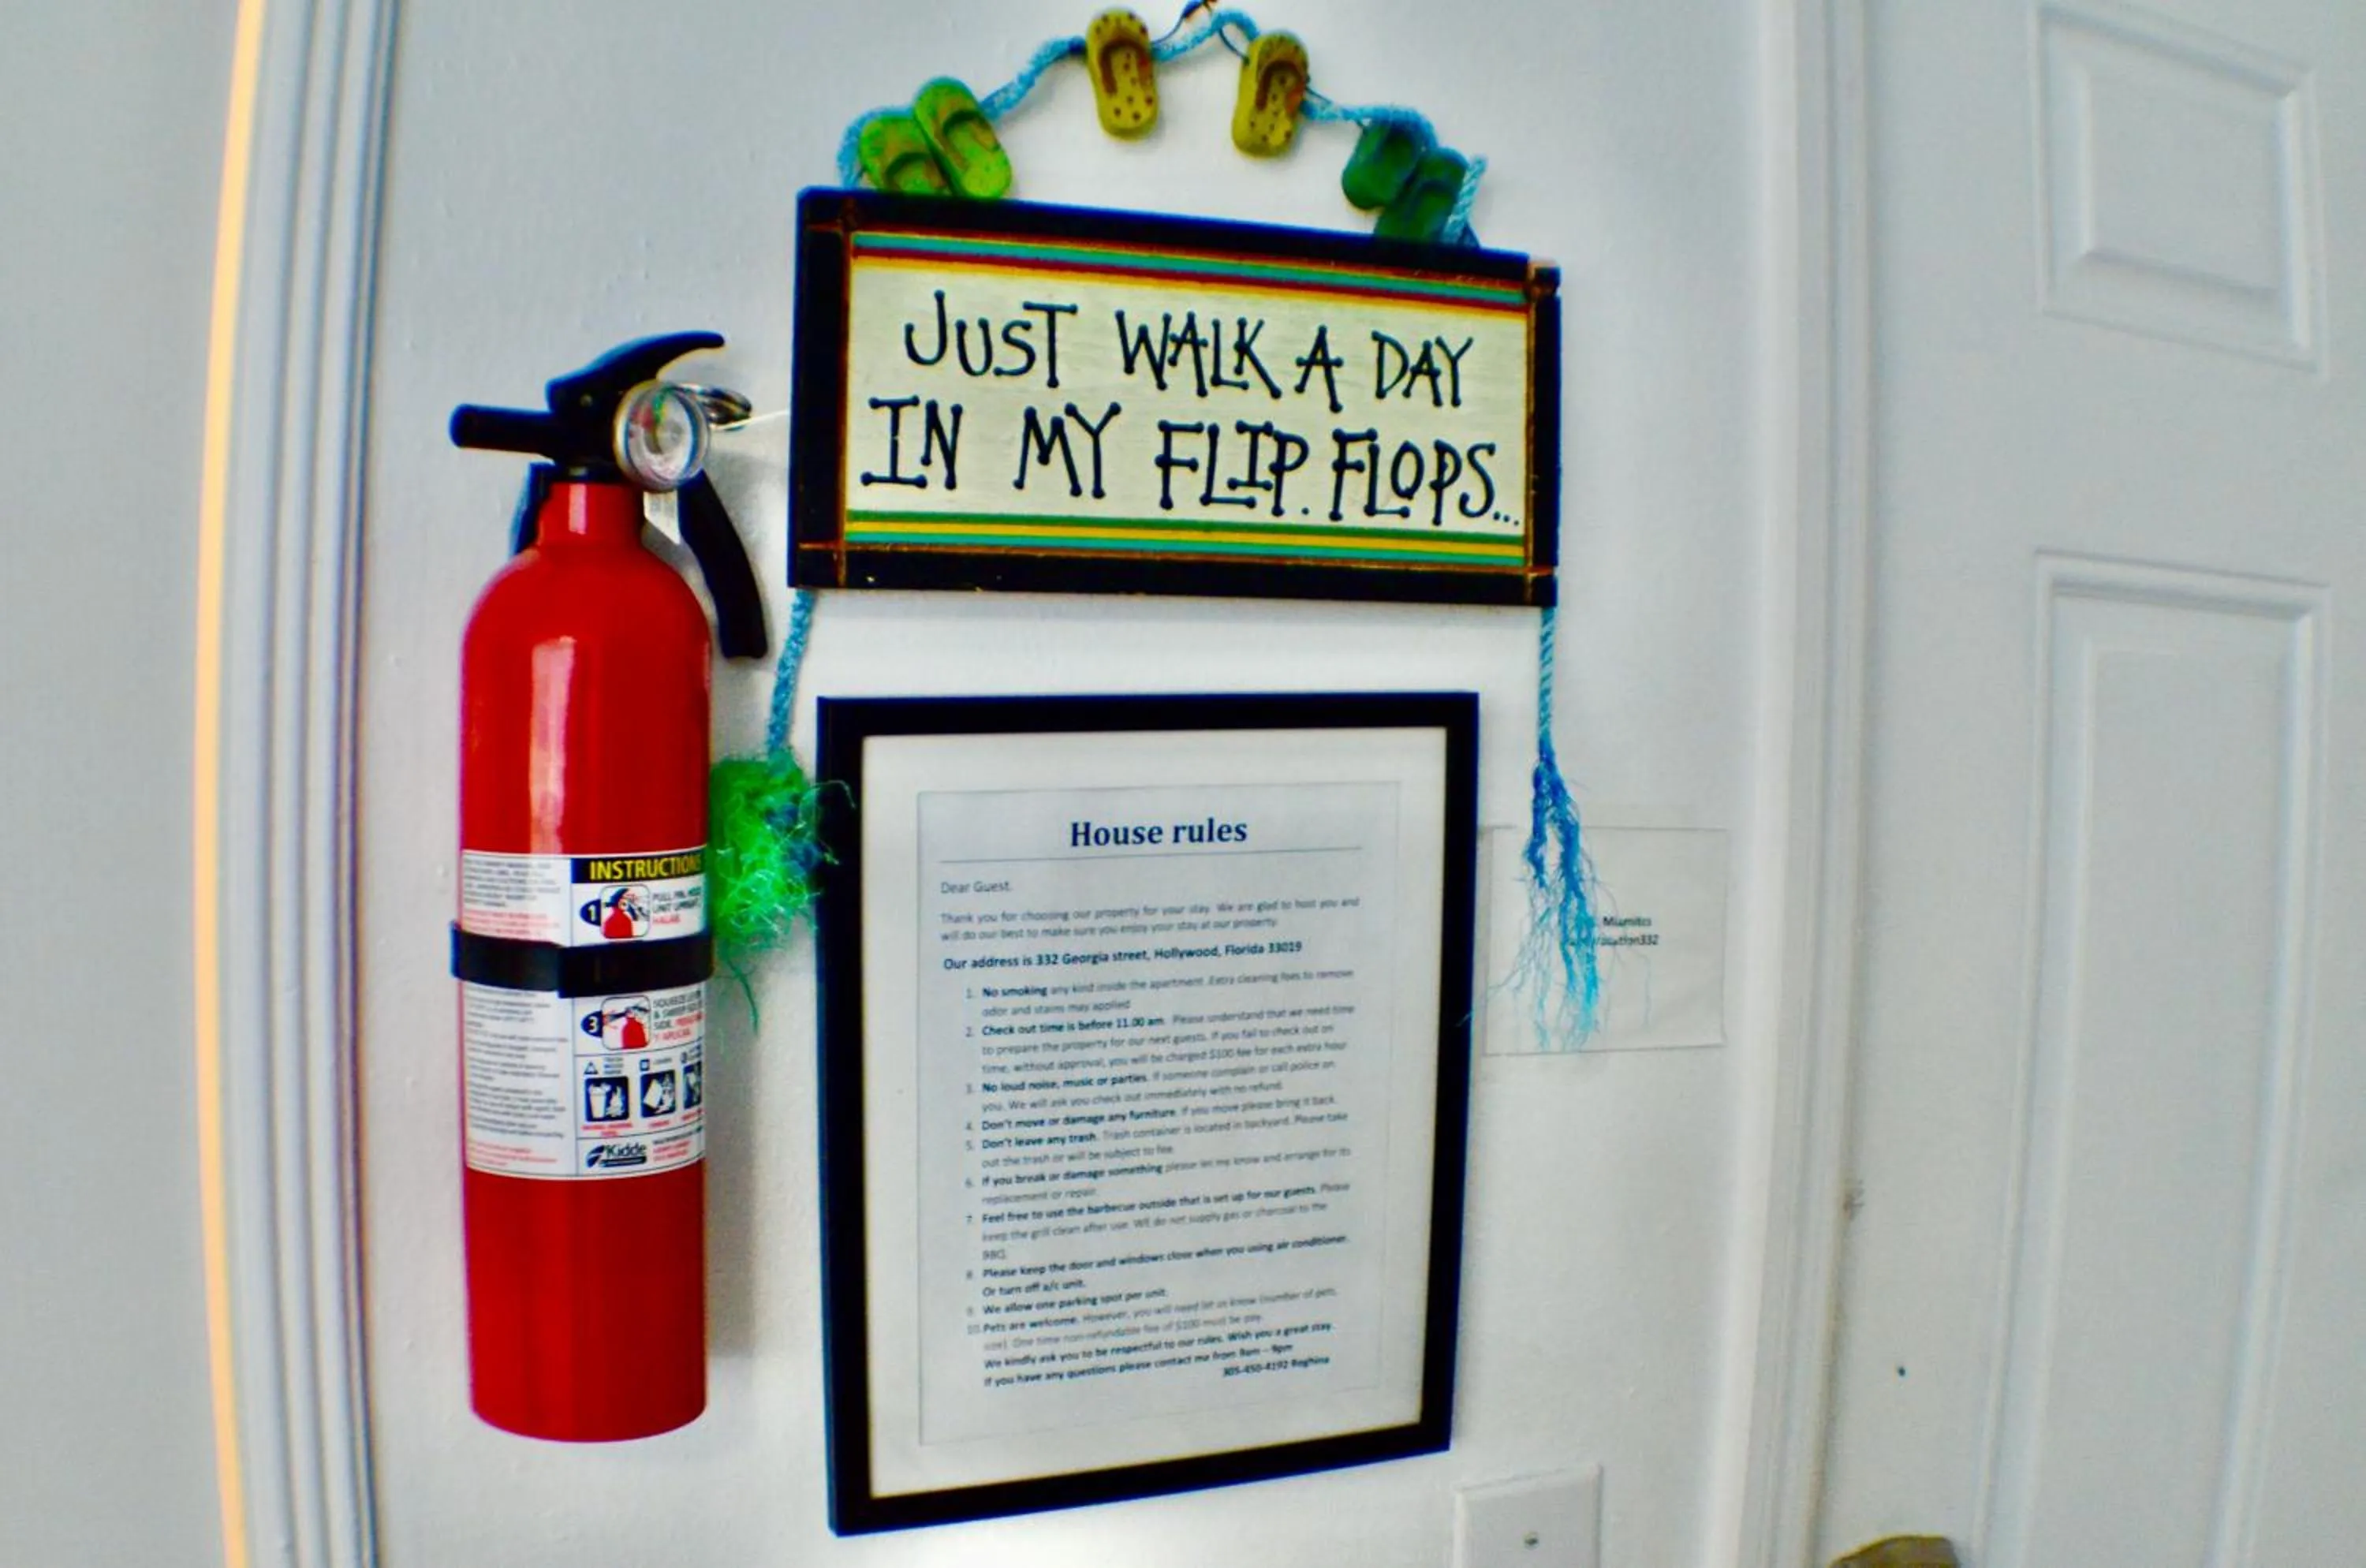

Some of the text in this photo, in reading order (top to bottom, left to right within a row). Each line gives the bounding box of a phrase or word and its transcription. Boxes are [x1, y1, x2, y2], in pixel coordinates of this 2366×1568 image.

[905, 290, 1473, 413] JUST WALK A DAY
[860, 396, 964, 490] IN
[1013, 402, 1121, 498] MY
[1070, 818, 1248, 849] House rules
[941, 883, 970, 893] Dear
[976, 913, 997, 924] you
[1002, 910, 1017, 920] for
[1021, 908, 1068, 920] choosing
[1095, 905, 1139, 920] property
[1144, 905, 1157, 914] for
[1162, 905, 1185, 917] your
[941, 928, 960, 939] will
[963, 928, 976, 939] do
[1001, 927, 1023, 937] best
[1027, 927, 1038, 936] to
[1041, 924, 1070, 935] make
[1099, 925, 1117, 936] you
[944, 942, 1302, 969] Our address is 332 Georgia street, Hollywood, Florida 33019
[982, 984, 1047, 997] No smoking
[982, 1006, 1007, 1017] odor
[1011, 1004, 1031, 1015] and
[1034, 1002, 1064, 1014] stains
[1068, 1003, 1089, 1014] may
[982, 1024, 1014, 1035] Check
[1017, 1023, 1036, 1032] out
[1039, 1021, 1064, 1032] time
[1067, 1020, 1075, 1030] is
[1078, 1018, 1112, 1029] before
[983, 1082, 997, 1092] No
[1001, 1080, 1025, 1091] loud
[1063, 1075, 1093, 1086] music
[982, 1119, 1012, 1130] Don't
[1015, 1118, 1044, 1128] move
[1063, 1114, 1104, 1125] damage
[1108, 1112, 1125, 1122] any
[607, 1143, 647, 1158] Kidde
[982, 1137, 1012, 1148] Don't
[1015, 1137, 1043, 1146] leave
[1047, 1135, 1065, 1145] any
[993, 1176, 1012, 1187] you
[1015, 1171, 1046, 1182] break
[1063, 1169, 1104, 1179] damage
[1108, 1163, 1162, 1175] something
[982, 1211, 1004, 1223] Feel
[1007, 1211, 1028, 1220] free
[1032, 1210, 1043, 1219] to
[1067, 1205, 1084, 1215] the
[1179, 1195, 1200, 1205] that
[1203, 1193, 1211, 1203] is
[1247, 1189, 1261, 1199] for
[983, 1267, 1017, 1277] Please
[1020, 1264, 1046, 1274] keep
[1049, 1260, 1065, 1270] the
[1068, 1259, 1093, 1268] door
[1096, 1255, 1115, 1265] and
[1226, 1245, 1245, 1256] you
[983, 1286, 996, 1296] Or
[998, 1286, 1021, 1294] turn
[1024, 1282, 1039, 1292] off
[983, 1305, 1001, 1315] We
[1004, 1302, 1032, 1312] allow
[1036, 1301, 1055, 1309] one
[1058, 1295, 1098, 1309] parking
[1100, 1293, 1122, 1305] spot
[1125, 1292, 1142, 1303] per
[983, 1323, 1006, 1332] Pets
[984, 1359, 1002, 1368] We
[1005, 1354, 1036, 1366] kindly
[1039, 1352, 1055, 1362] ask
[1059, 1351, 1079, 1362] you
[1095, 1346, 1107, 1356] be
[1110, 1339, 1162, 1354] respectful
[1164, 1339, 1175, 1348] to
[1177, 1338, 1195, 1346] our
[1254, 1329, 1272, 1340] you
[995, 1376, 1014, 1388] you
[1017, 1373, 1042, 1383] have
[1045, 1371, 1063, 1380] any
[1067, 1365, 1115, 1379] questions
[1119, 1361, 1151, 1373] please
[1154, 1354, 1191, 1366] contact
